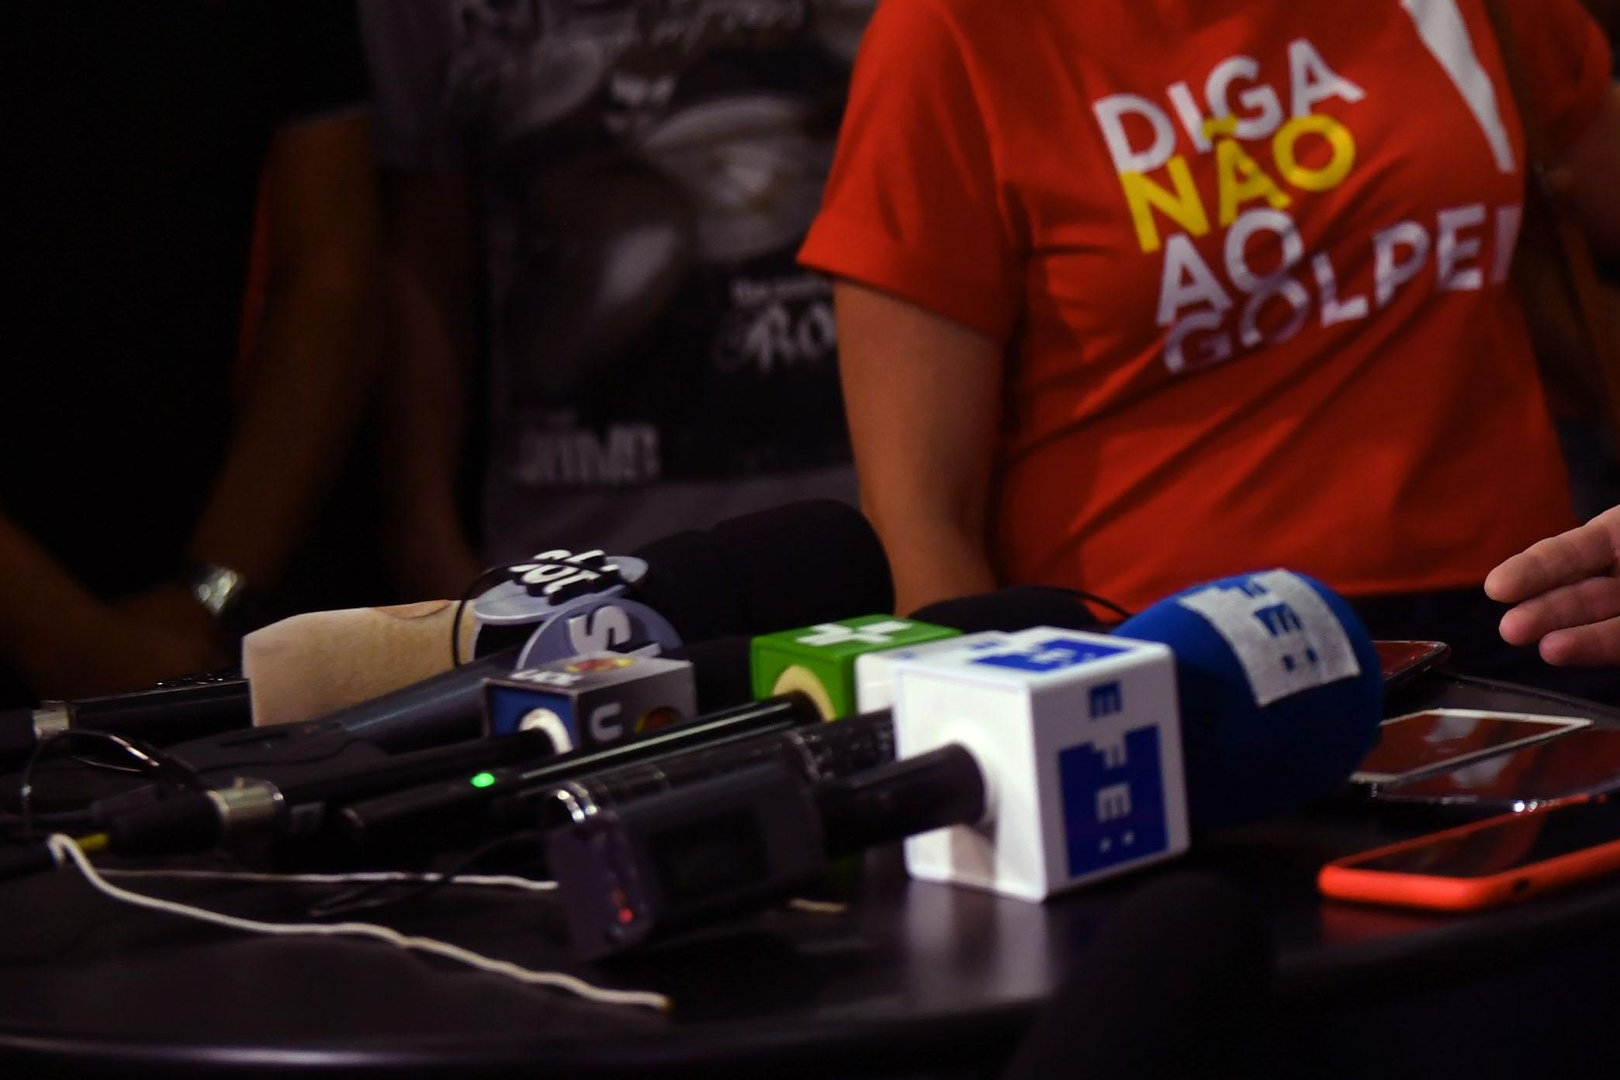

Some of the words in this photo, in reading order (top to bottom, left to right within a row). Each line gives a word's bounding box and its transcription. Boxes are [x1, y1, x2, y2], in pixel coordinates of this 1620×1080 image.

[1092, 38, 1367, 177] DIGA
[1119, 113, 1356, 254] NÃO
[1156, 207, 1304, 327] AO
